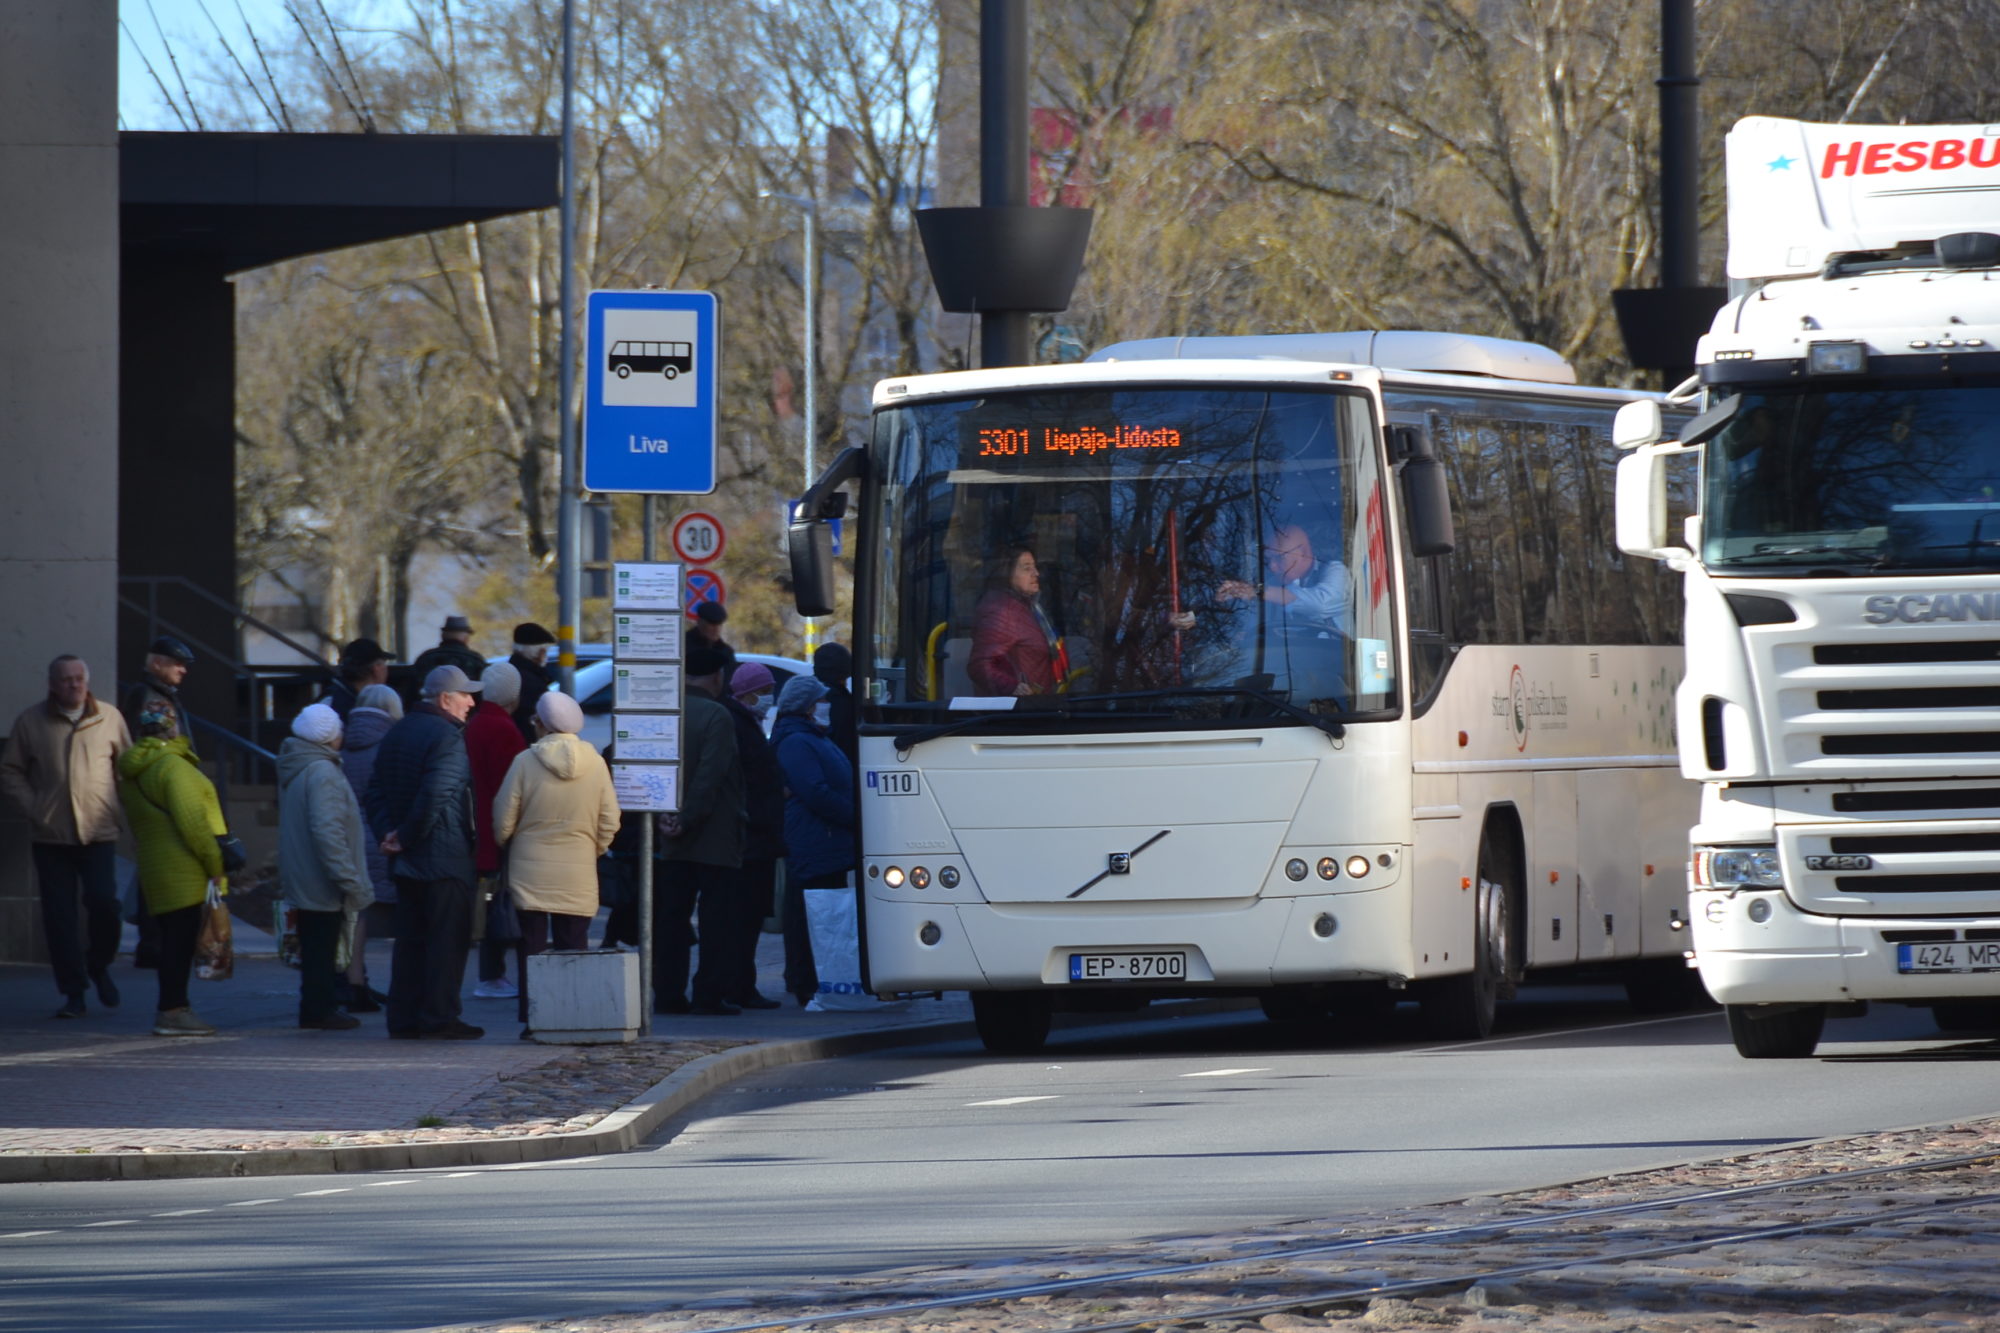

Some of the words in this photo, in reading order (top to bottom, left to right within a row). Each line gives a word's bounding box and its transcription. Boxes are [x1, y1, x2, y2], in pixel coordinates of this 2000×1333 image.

[1821, 138, 2000, 179] HESBU
[629, 435, 668, 453] Līva
[1044, 425, 1180, 455] Liepāja-Lidosta
[686, 526, 711, 551] 30
[882, 773, 912, 793] 110
[1807, 856, 1822, 869] R
[1824, 855, 1868, 870] 420
[1086, 956, 1181, 977] EP-8700
[1918, 946, 1955, 968] 424
